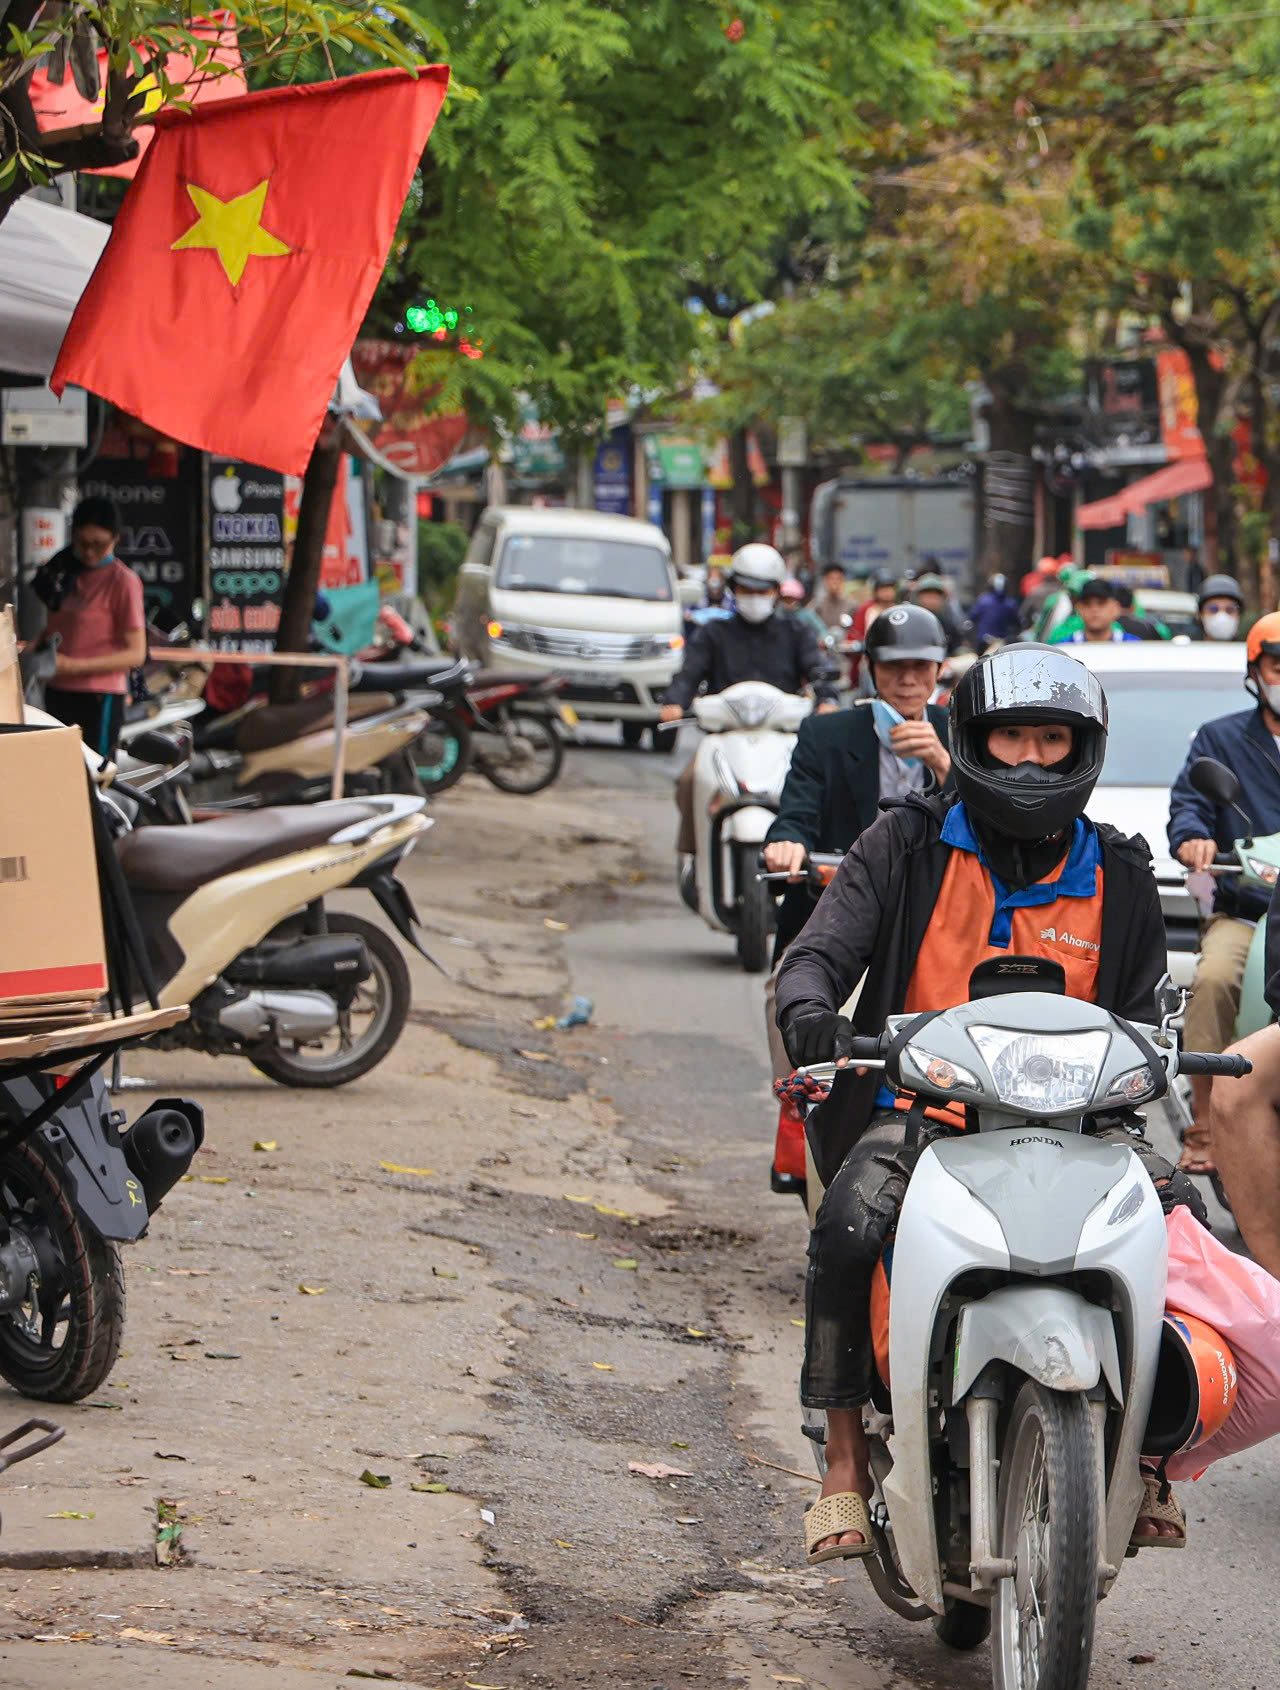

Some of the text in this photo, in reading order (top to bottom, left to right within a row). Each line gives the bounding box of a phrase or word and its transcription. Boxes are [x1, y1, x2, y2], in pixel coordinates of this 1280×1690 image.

[213, 513, 281, 542] NOKIA
[210, 548, 283, 569] SAMSUNG
[1009, 1136, 1065, 1149] HONDA
[1215, 1349, 1229, 1405] Ahamove
